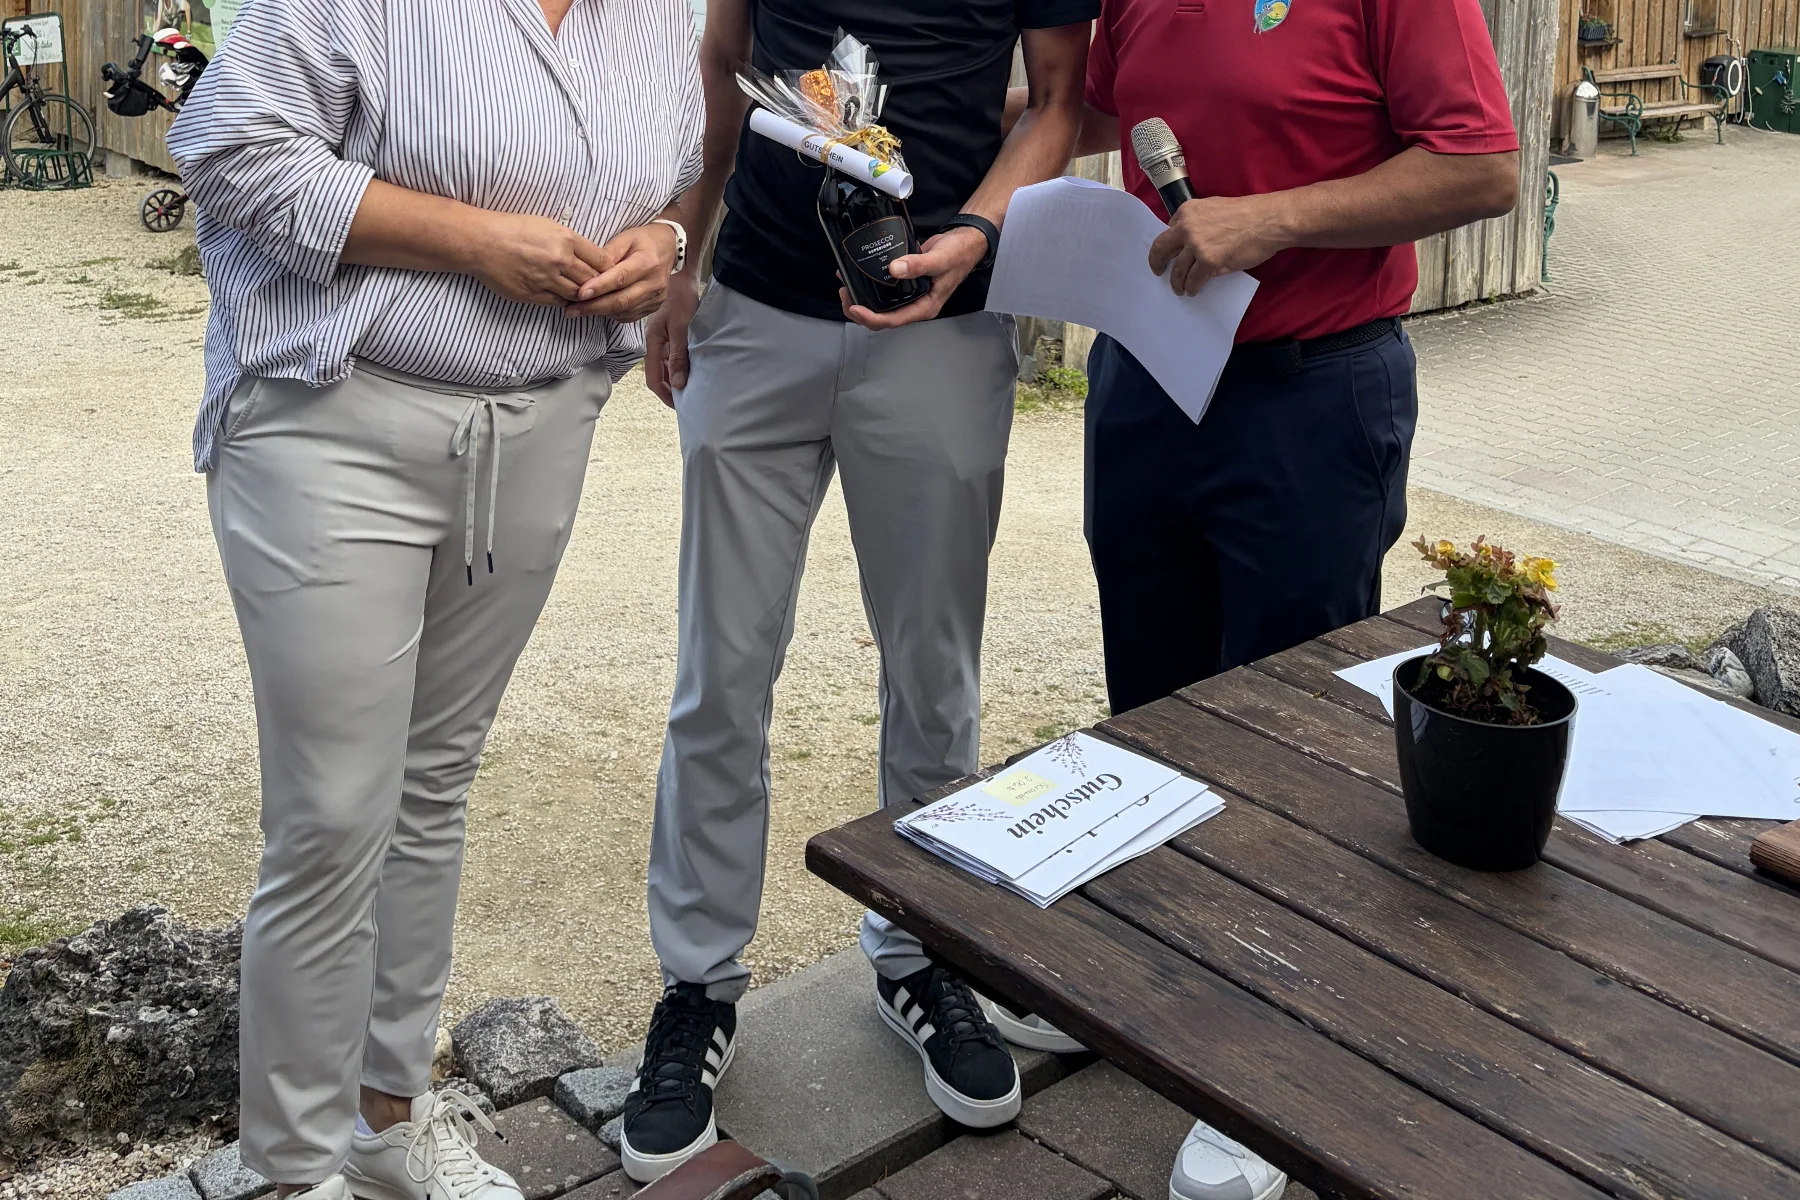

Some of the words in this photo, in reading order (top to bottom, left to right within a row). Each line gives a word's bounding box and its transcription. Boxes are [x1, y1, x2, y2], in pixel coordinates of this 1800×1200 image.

[804, 140, 844, 163] GUTSHEIN
[861, 234, 894, 251] PROSECCO
[1007, 773, 1123, 839] Gutschein
